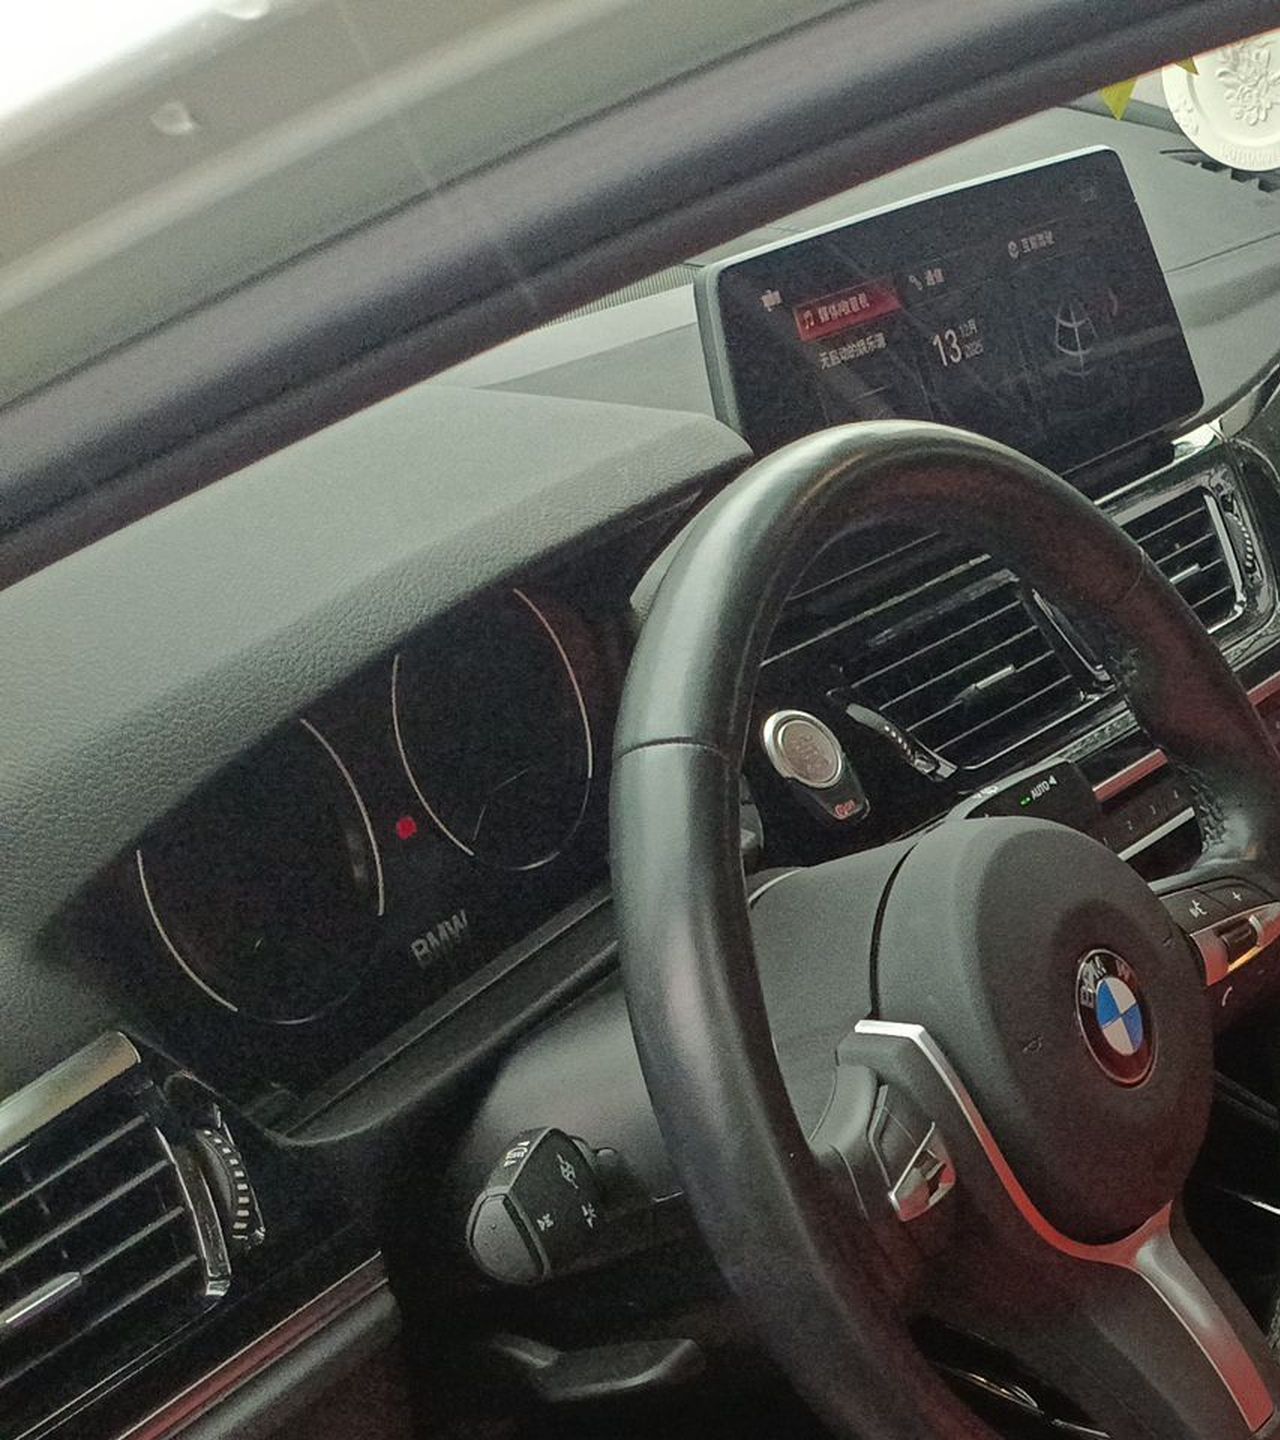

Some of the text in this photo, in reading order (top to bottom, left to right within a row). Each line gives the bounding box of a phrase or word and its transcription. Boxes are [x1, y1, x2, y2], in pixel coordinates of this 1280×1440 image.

[933, 329, 962, 367] 13
[1030, 780, 1051, 801] AUTO
[410, 909, 468, 961] BMW
[1080, 955, 1132, 1009] BMW
